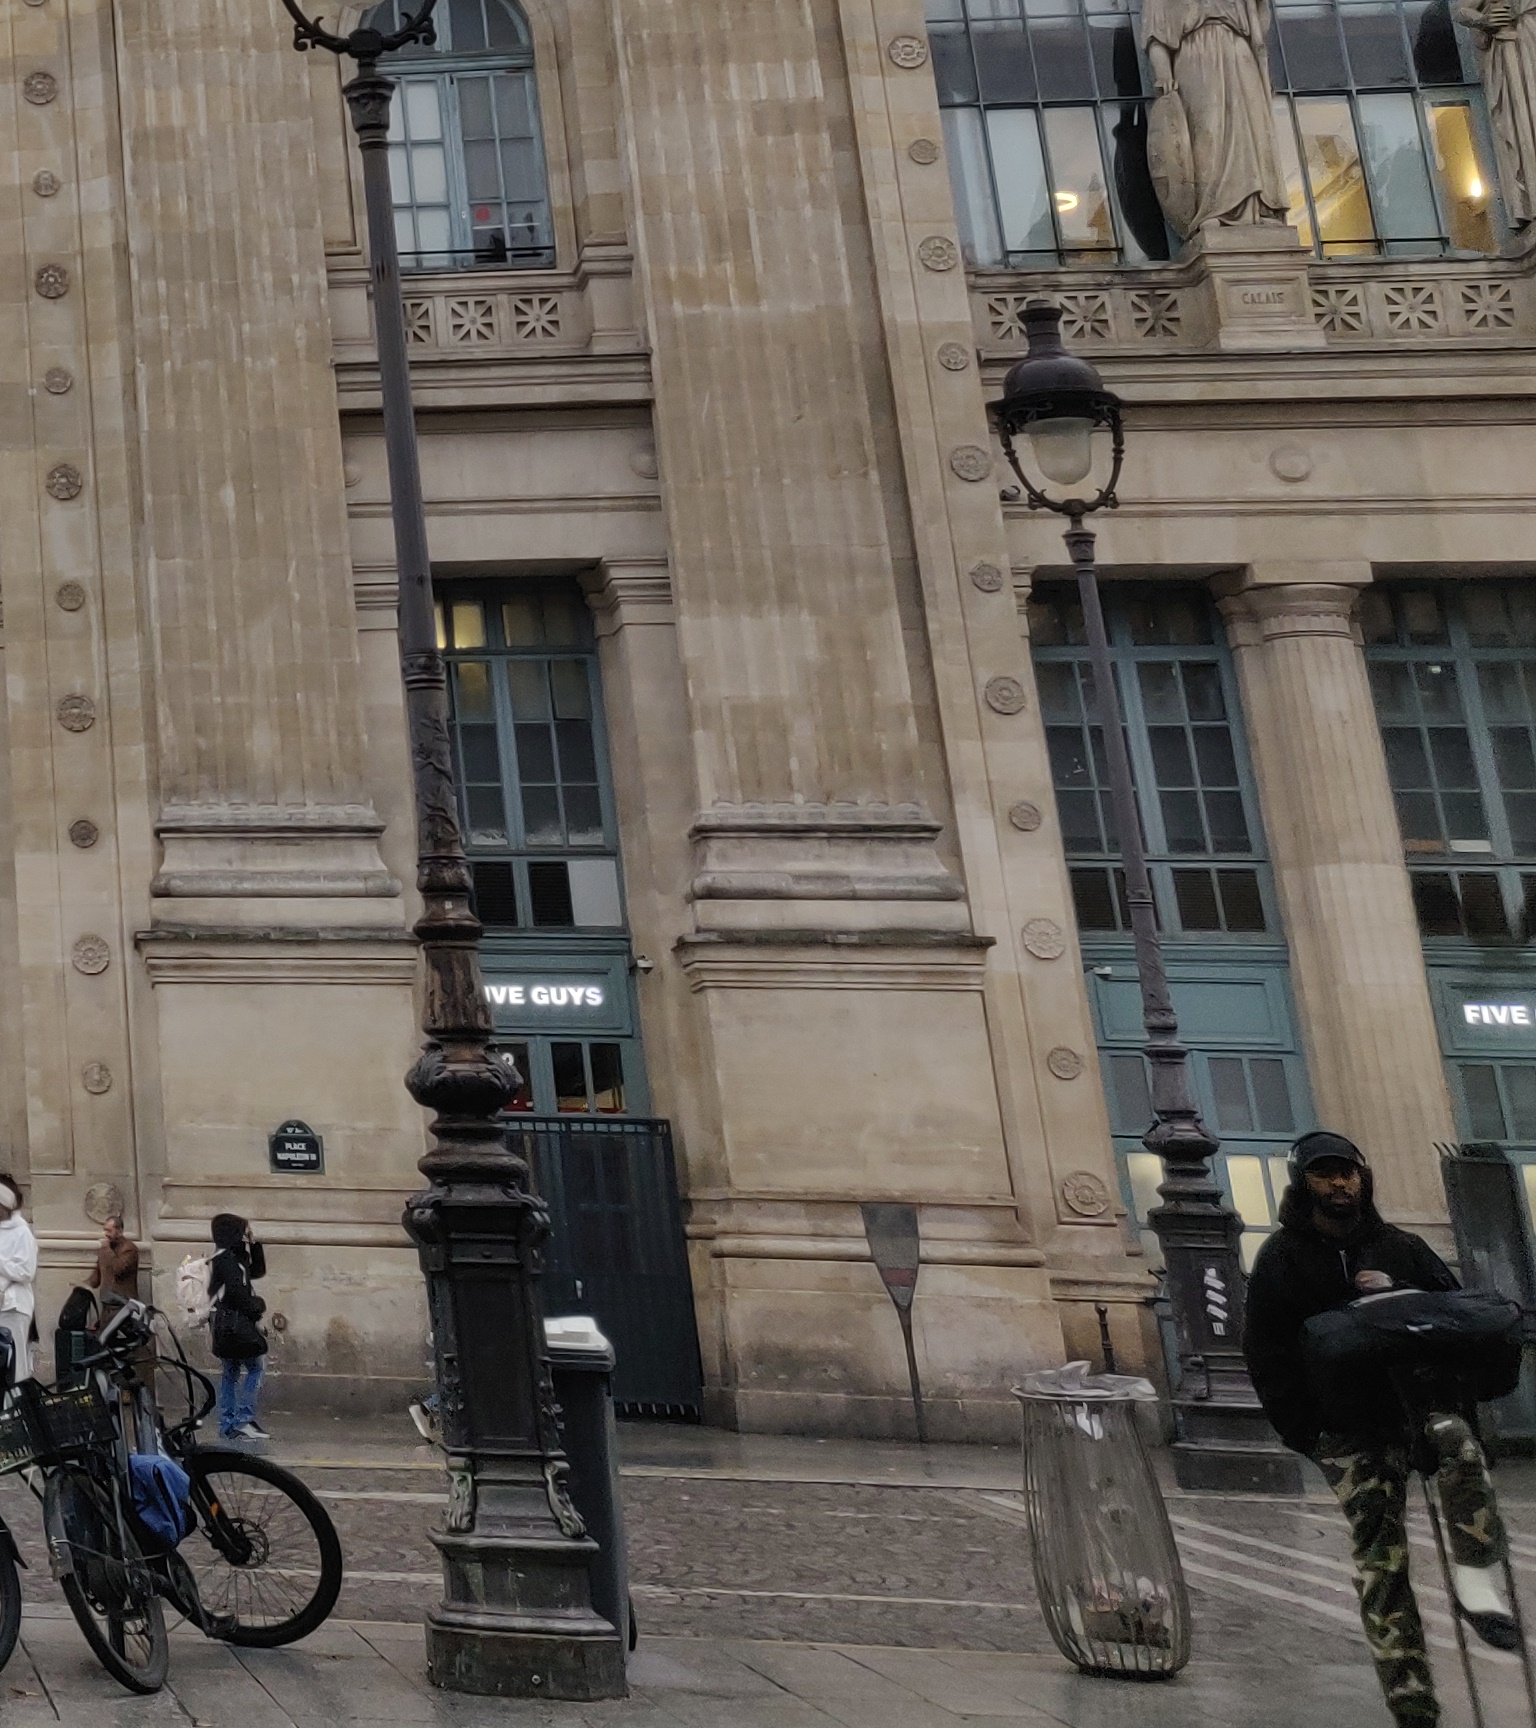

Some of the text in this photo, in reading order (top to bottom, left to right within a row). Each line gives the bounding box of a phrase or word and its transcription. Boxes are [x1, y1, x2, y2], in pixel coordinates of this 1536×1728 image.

[1242, 292, 1285, 304] CALAIS
[484, 985, 604, 1006] IVE GUYS
[1463, 1004, 1531, 1025] FIVE
[284, 1142, 307, 1151] PLACE
